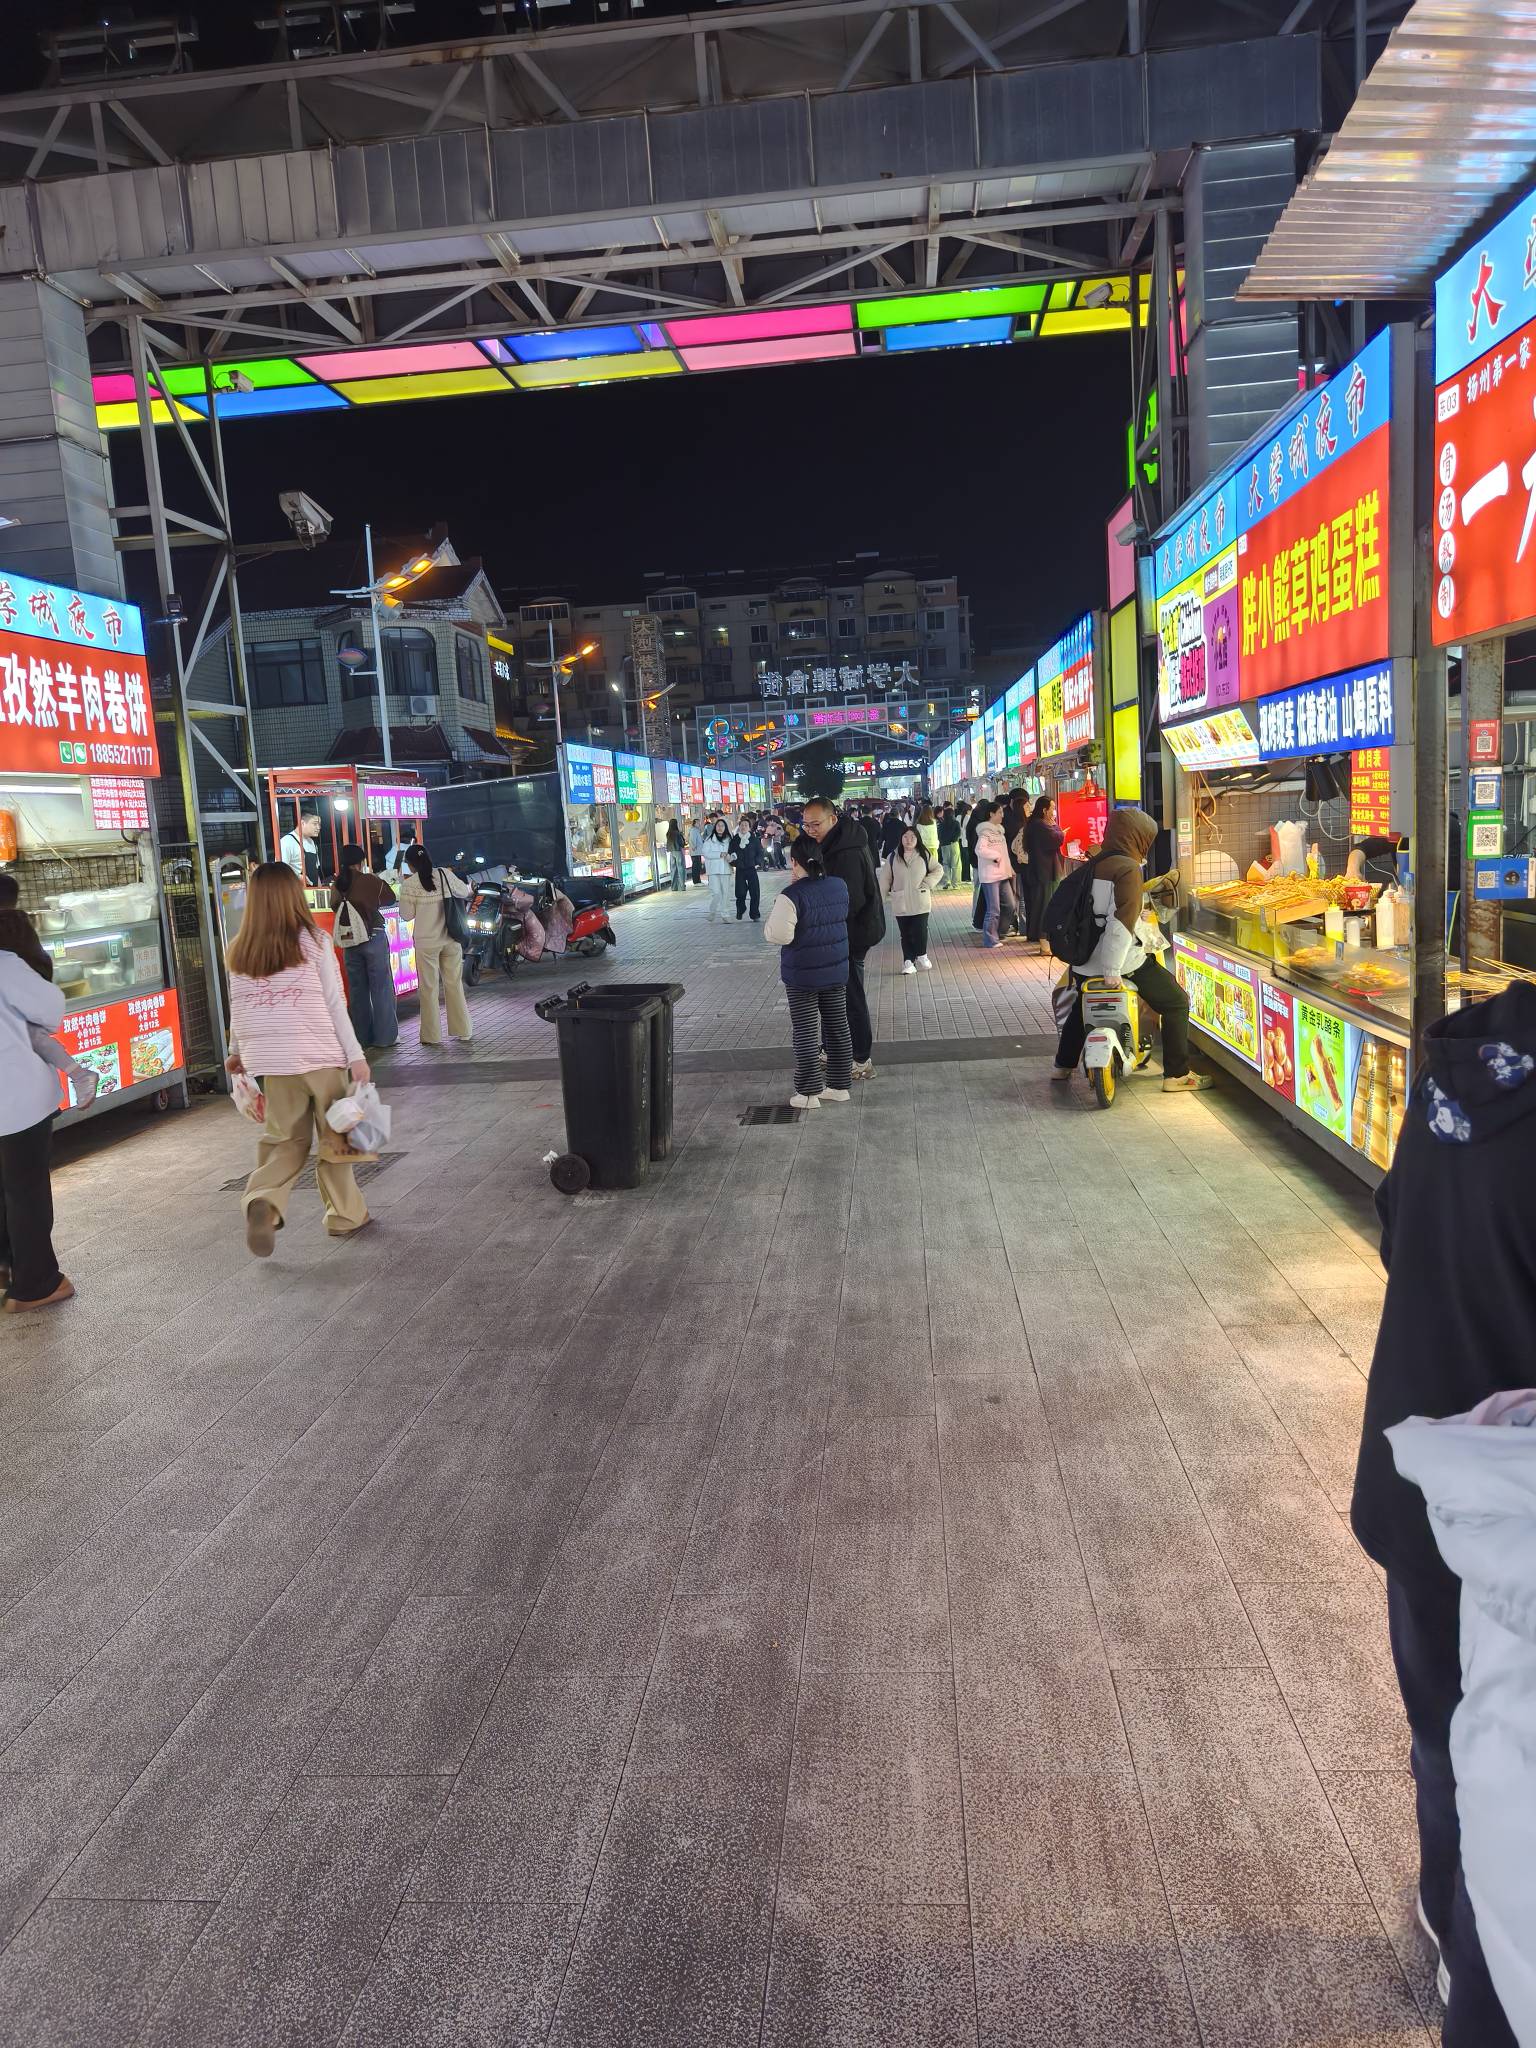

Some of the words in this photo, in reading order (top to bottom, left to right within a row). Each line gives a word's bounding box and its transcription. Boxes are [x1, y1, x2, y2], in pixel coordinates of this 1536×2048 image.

[1465, 336, 1531, 404] 扬州第一家
[1248, 362, 1366, 518] 大学城夜市
[1162, 493, 1226, 584] 大学城夜市
[1242, 489, 1381, 657] 胖小熊草鸡蛋糕
[0, 652, 148, 736] 孜然羊肉卷饼
[1297, 685, 1338, 745] 低糖减油
[1342, 670, 1393, 739] 山姆原料
[89, 743, 153, 766] 18855271177
[1358, 750, 1381, 768] 价目表
[1301, 1004, 1341, 1040] 黄金乳酪条
